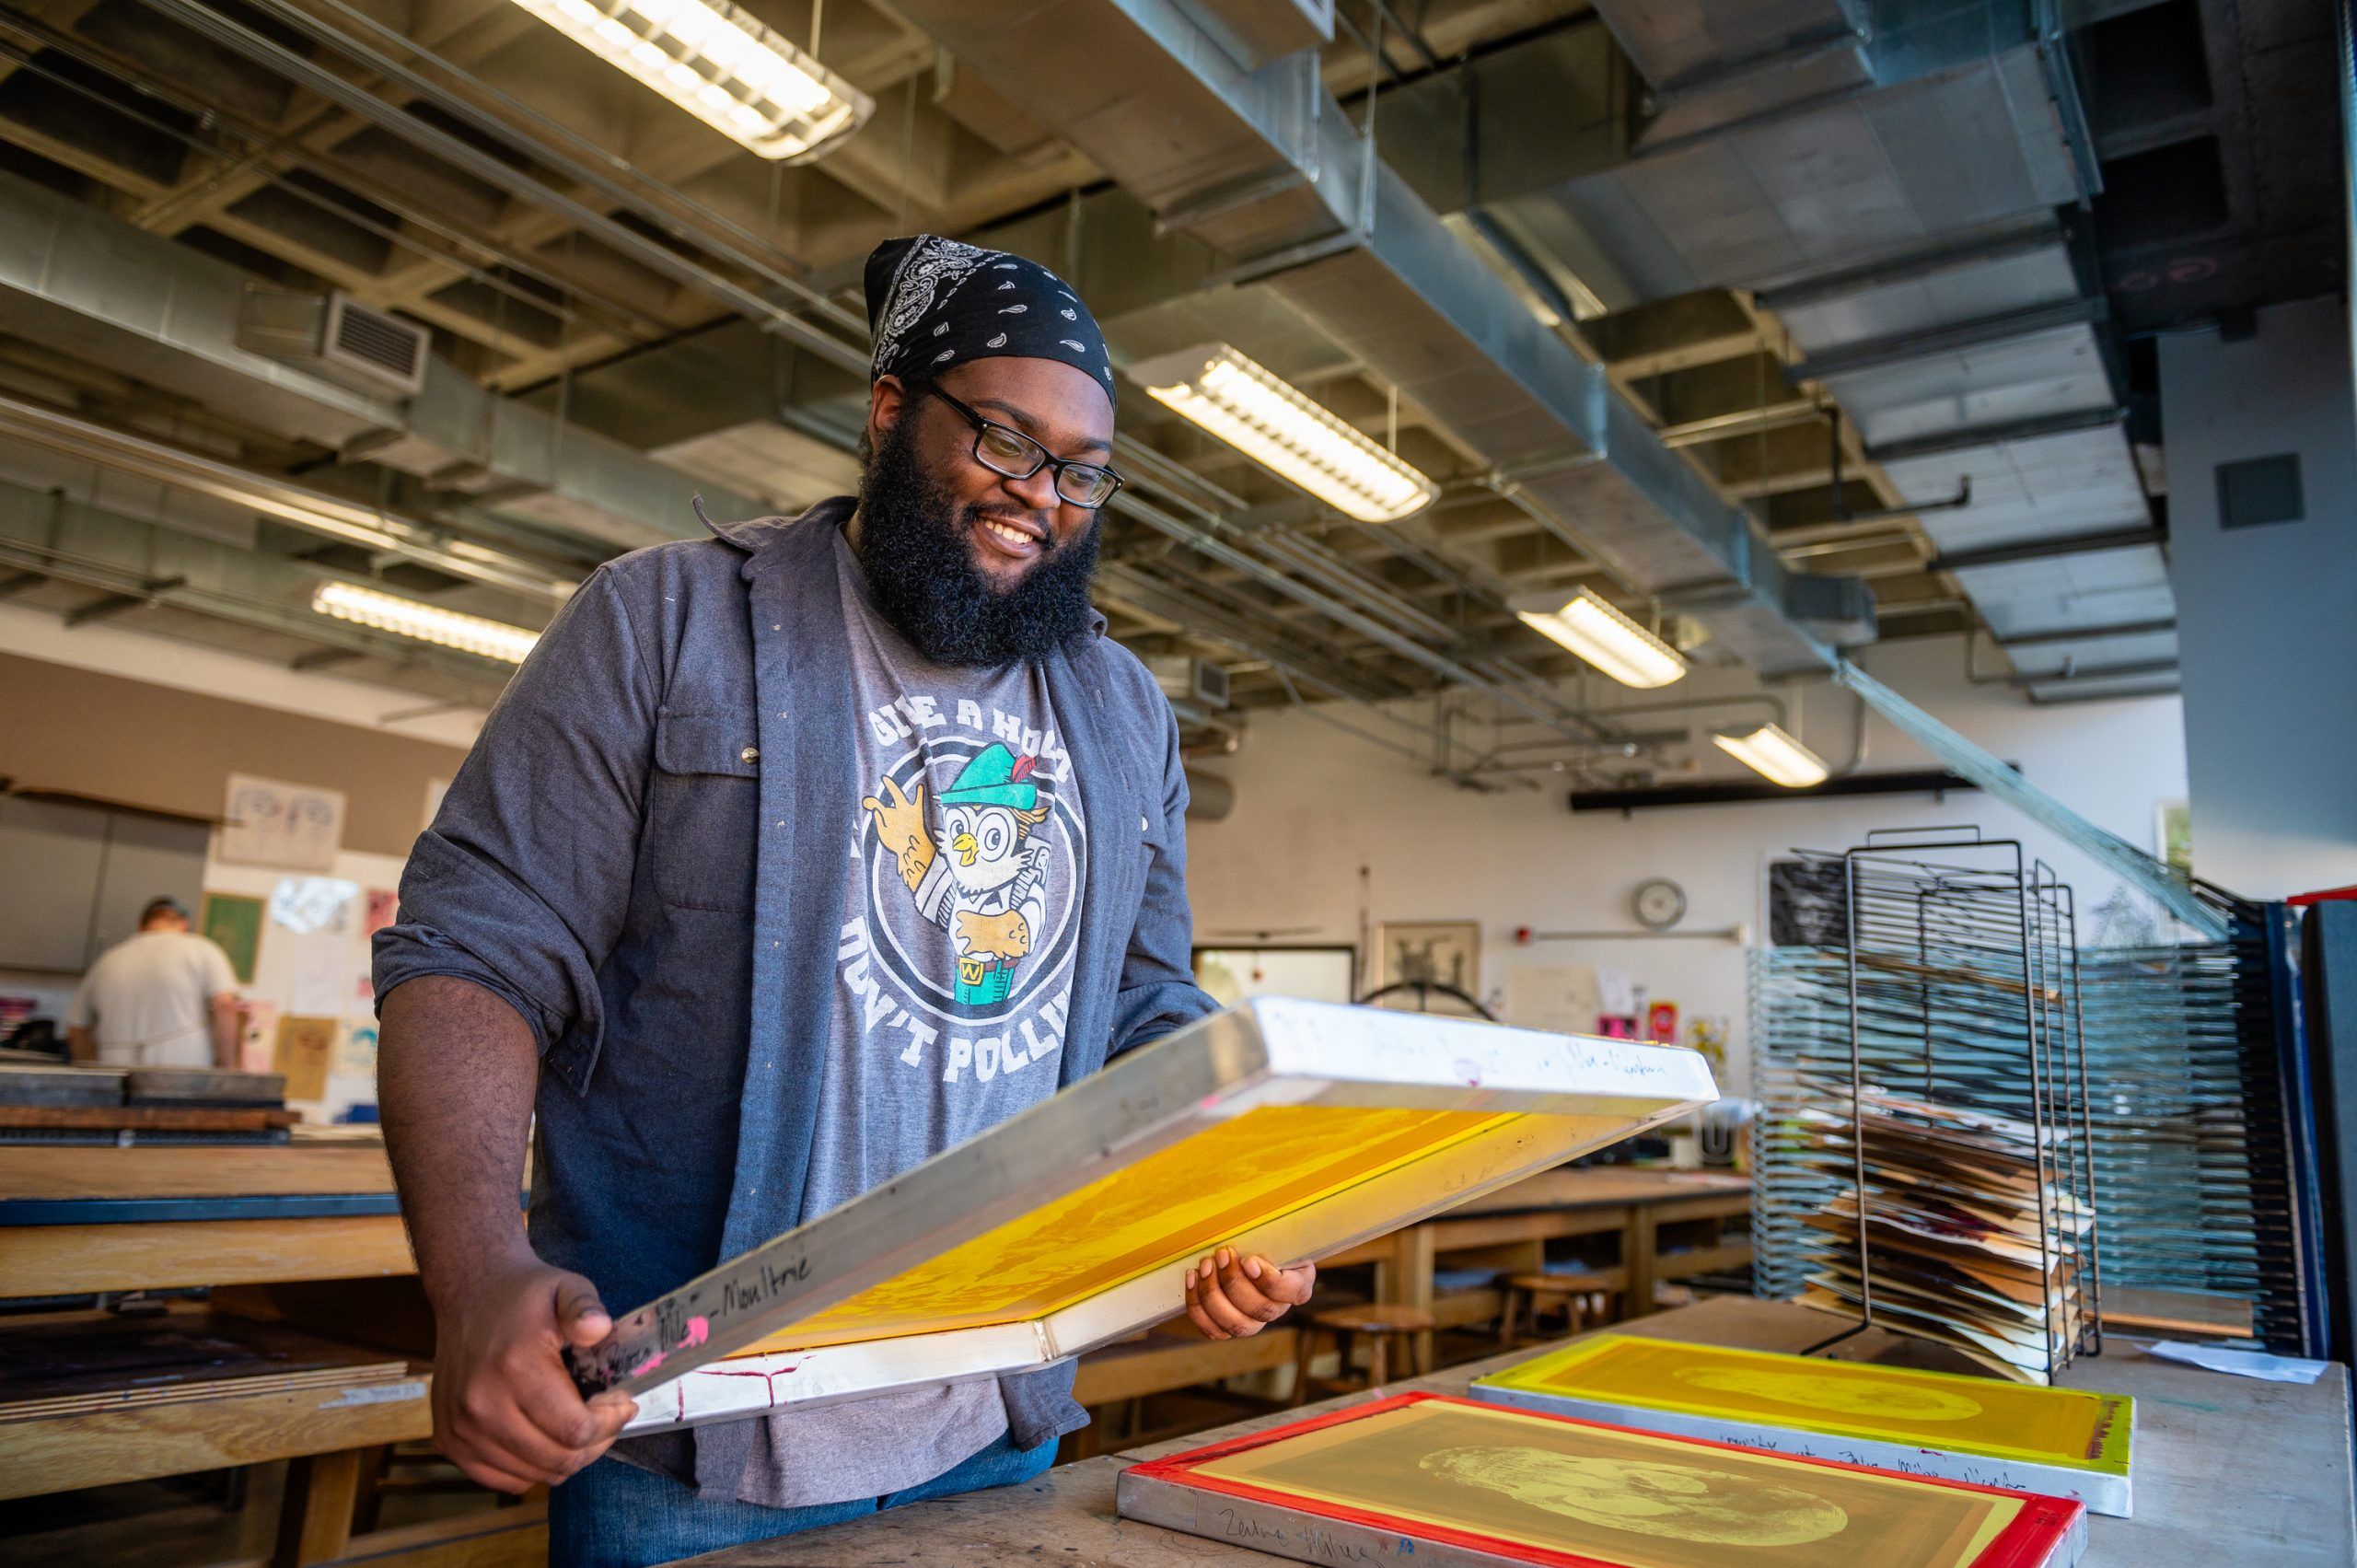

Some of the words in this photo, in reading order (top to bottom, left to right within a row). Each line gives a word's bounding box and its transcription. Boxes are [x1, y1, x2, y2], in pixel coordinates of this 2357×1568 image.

[867, 693, 947, 747] GIVE
[956, 698, 983, 731] A
[960, 962, 981, 980] W
